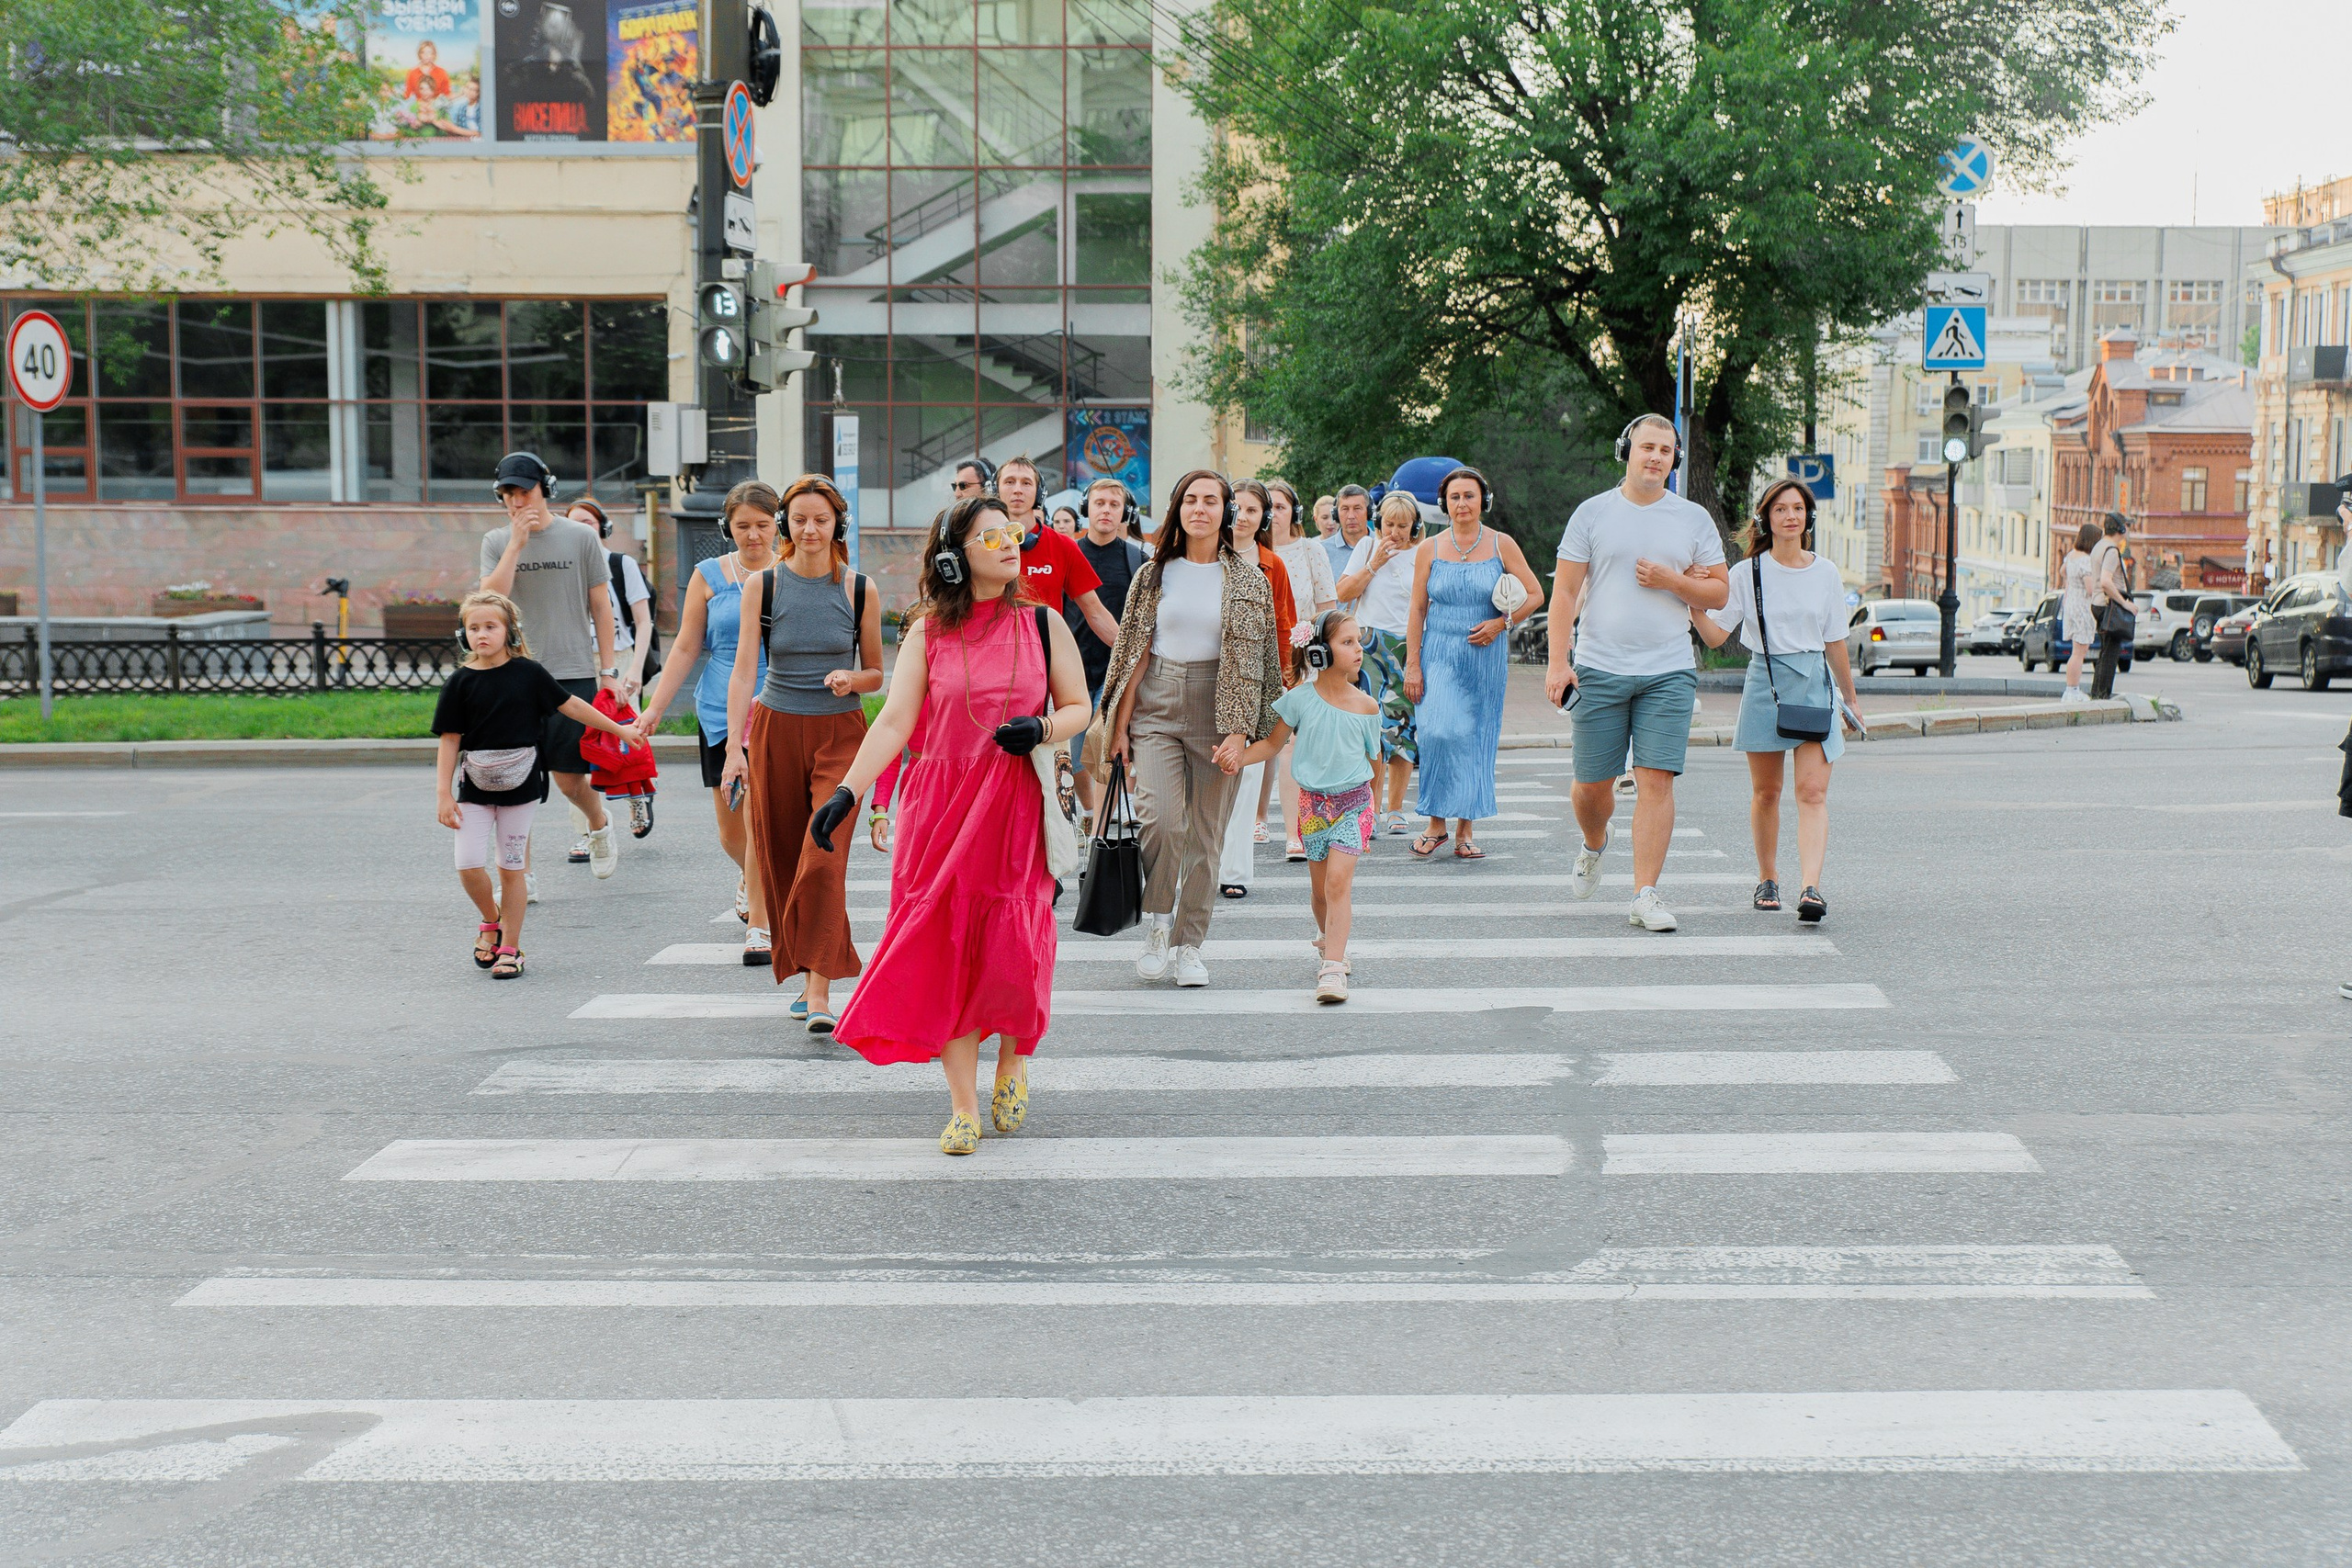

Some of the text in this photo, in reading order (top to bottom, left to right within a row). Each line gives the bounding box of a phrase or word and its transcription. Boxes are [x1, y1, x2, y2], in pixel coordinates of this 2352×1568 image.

[713, 290, 738, 316] 13
[22, 342, 55, 379] 40
[1798, 459, 1825, 485] P
